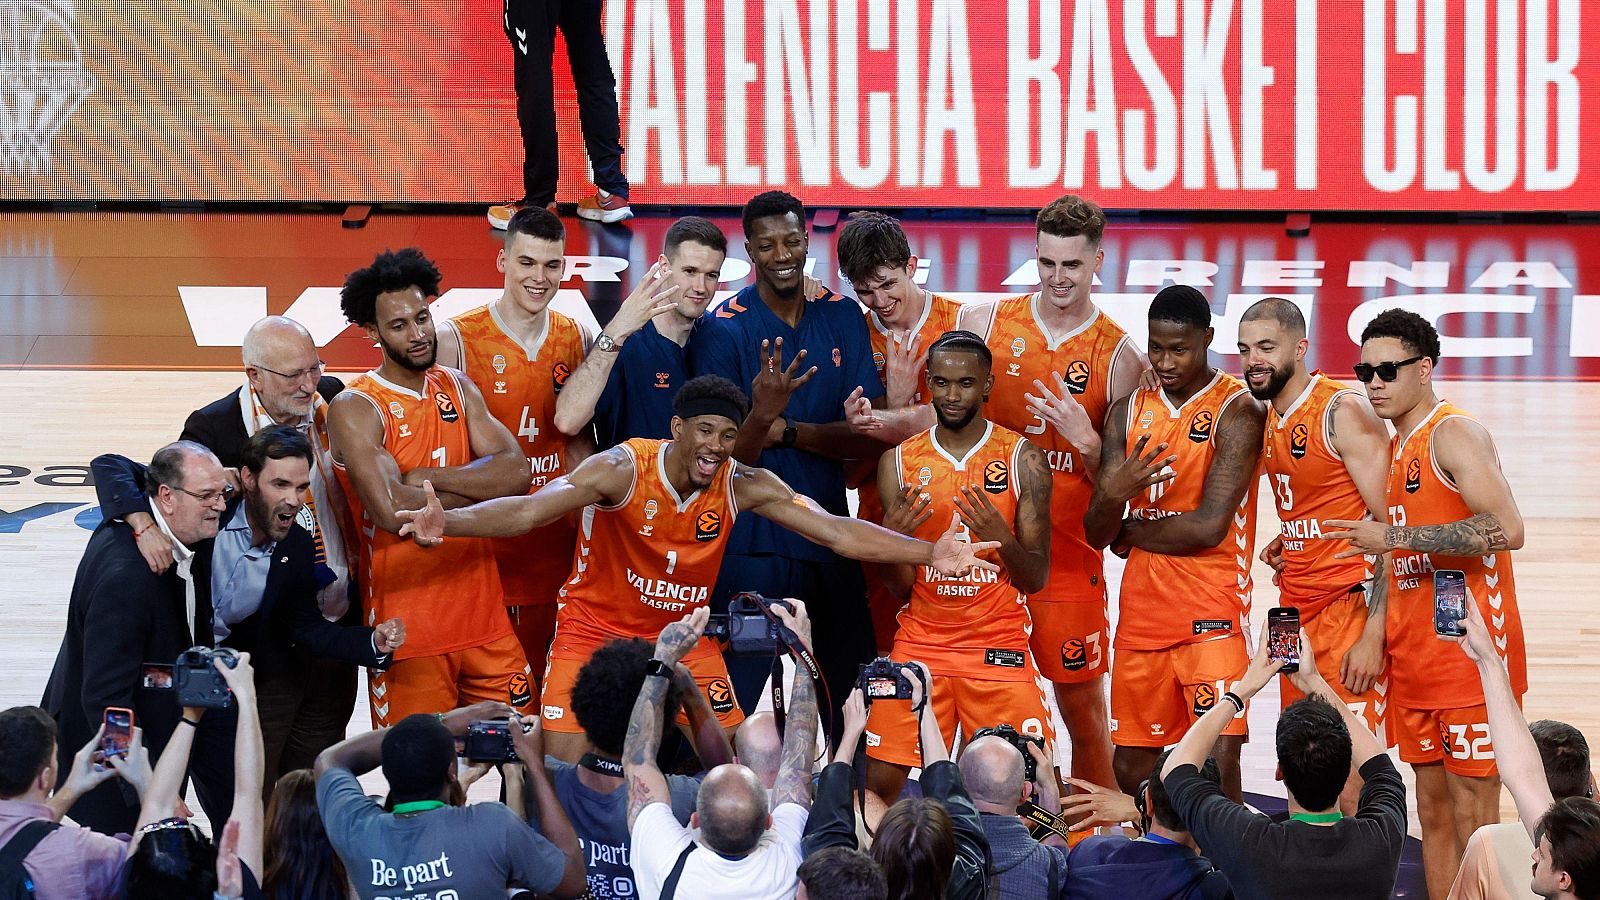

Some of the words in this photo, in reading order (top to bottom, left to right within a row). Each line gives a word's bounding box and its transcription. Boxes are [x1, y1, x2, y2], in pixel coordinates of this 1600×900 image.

[1007, 0, 1318, 190] BASKET
[1362, 0, 1581, 192] CLUB
[518, 405, 539, 443] 4
[1281, 518, 1322, 539] ENCIA
[666, 550, 677, 575] 1
[627, 567, 708, 603] VALENCIA
[937, 585, 980, 597] BASKET
[640, 595, 686, 612] BASKET
[801, 650, 819, 679] Canon
[1086, 631, 1101, 671] 3
[1449, 723, 1495, 760] 32
[1032, 810, 1051, 824] Nikon
[589, 840, 630, 867] part
[371, 858, 398, 887] Be
[402, 851, 453, 891] part
